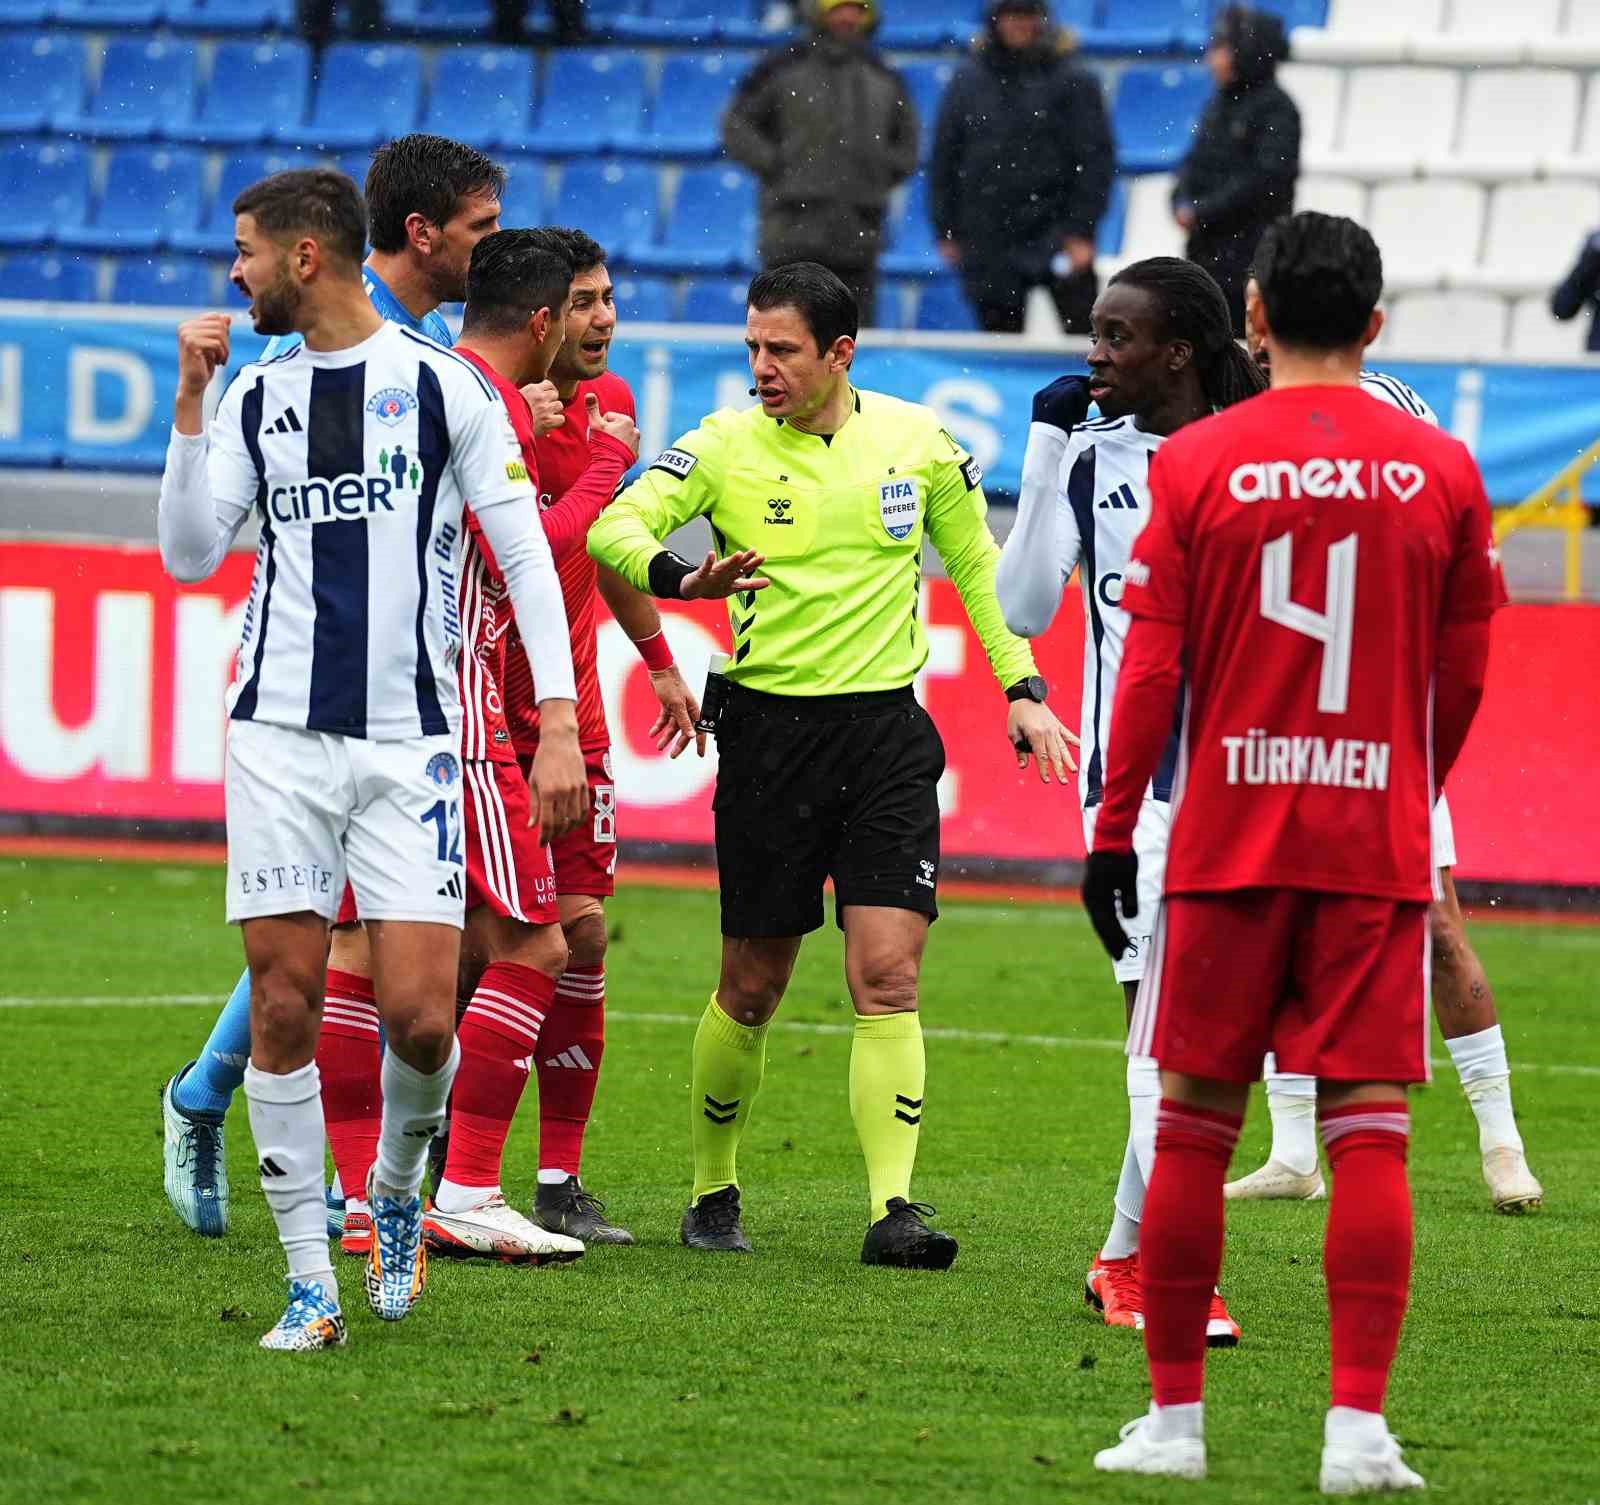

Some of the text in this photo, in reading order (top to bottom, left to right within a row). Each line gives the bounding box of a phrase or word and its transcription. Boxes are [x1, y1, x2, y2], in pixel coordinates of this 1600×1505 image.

[882, 482, 913, 501] FIFA
[1229, 458, 1366, 503] anex
[882, 502, 917, 516] REFEREE
[1260, 531, 1358, 714] 4
[1221, 728, 1391, 792] TÜRKMEN
[420, 800, 463, 866] 12
